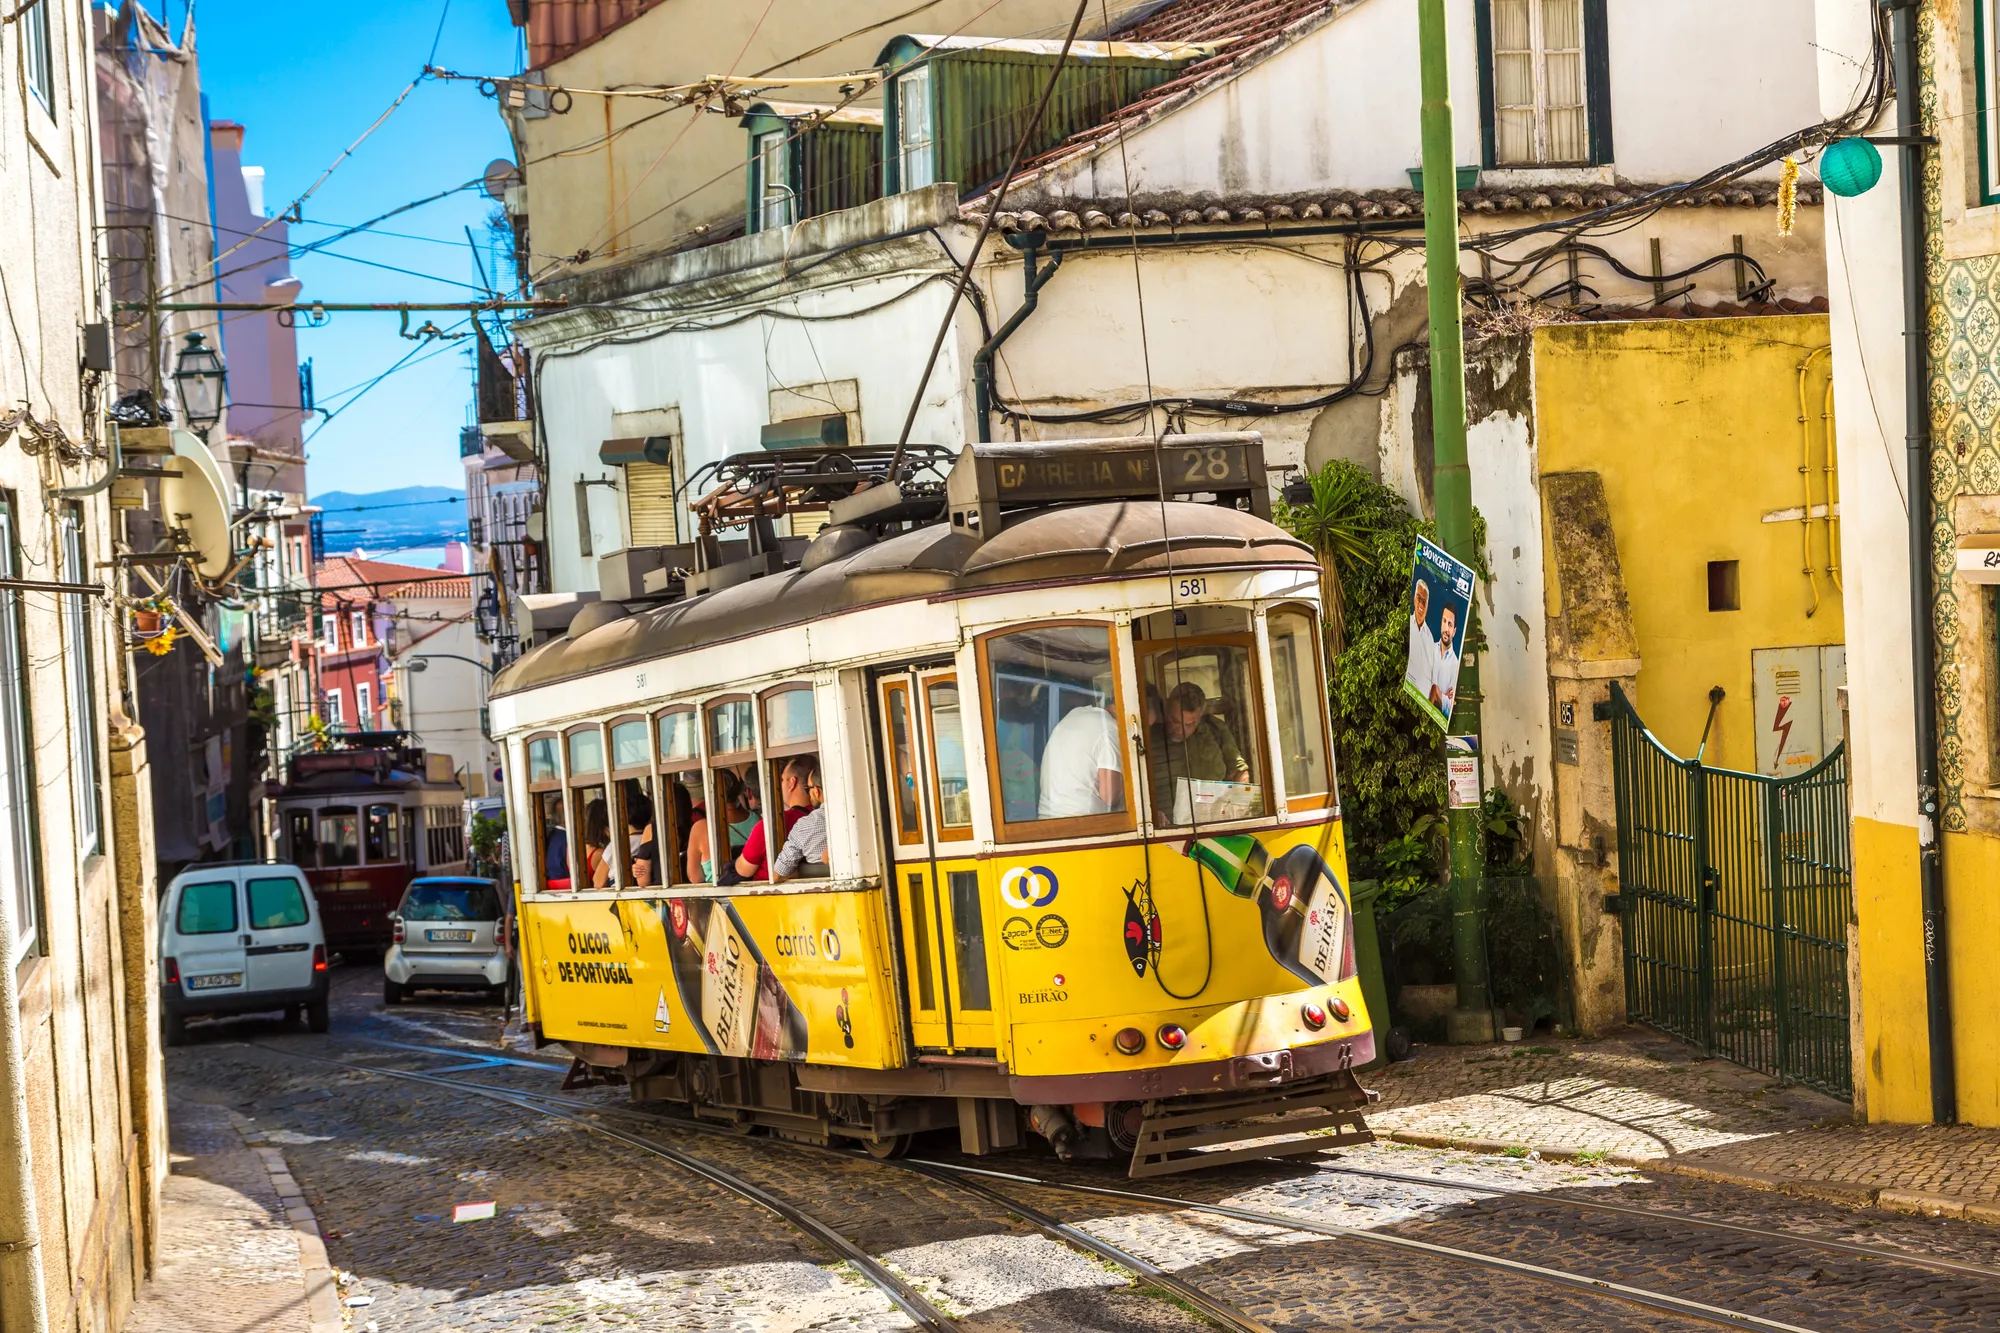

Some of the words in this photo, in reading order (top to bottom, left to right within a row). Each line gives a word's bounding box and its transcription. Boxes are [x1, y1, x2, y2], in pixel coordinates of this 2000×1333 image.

[1182, 448, 1230, 482] 28
[1422, 545, 1433, 560] SÃO
[1432, 552, 1453, 574] VICENTE
[1180, 577, 1207, 597] 581
[636, 673, 648, 689] 581
[1561, 703, 1572, 724] 85
[568, 932, 577, 954] O
[577, 932, 612, 954] LICOR
[776, 925, 816, 956] carris
[1007, 929, 1028, 939] apcer
[1314, 892, 1337, 974] BEIRÃO
[558, 961, 574, 982] DE
[573, 961, 633, 984] PORTUGAL
[716, 934, 740, 1049] BEIRÃO
[1019, 989, 1068, 1005] BEIRÃO
